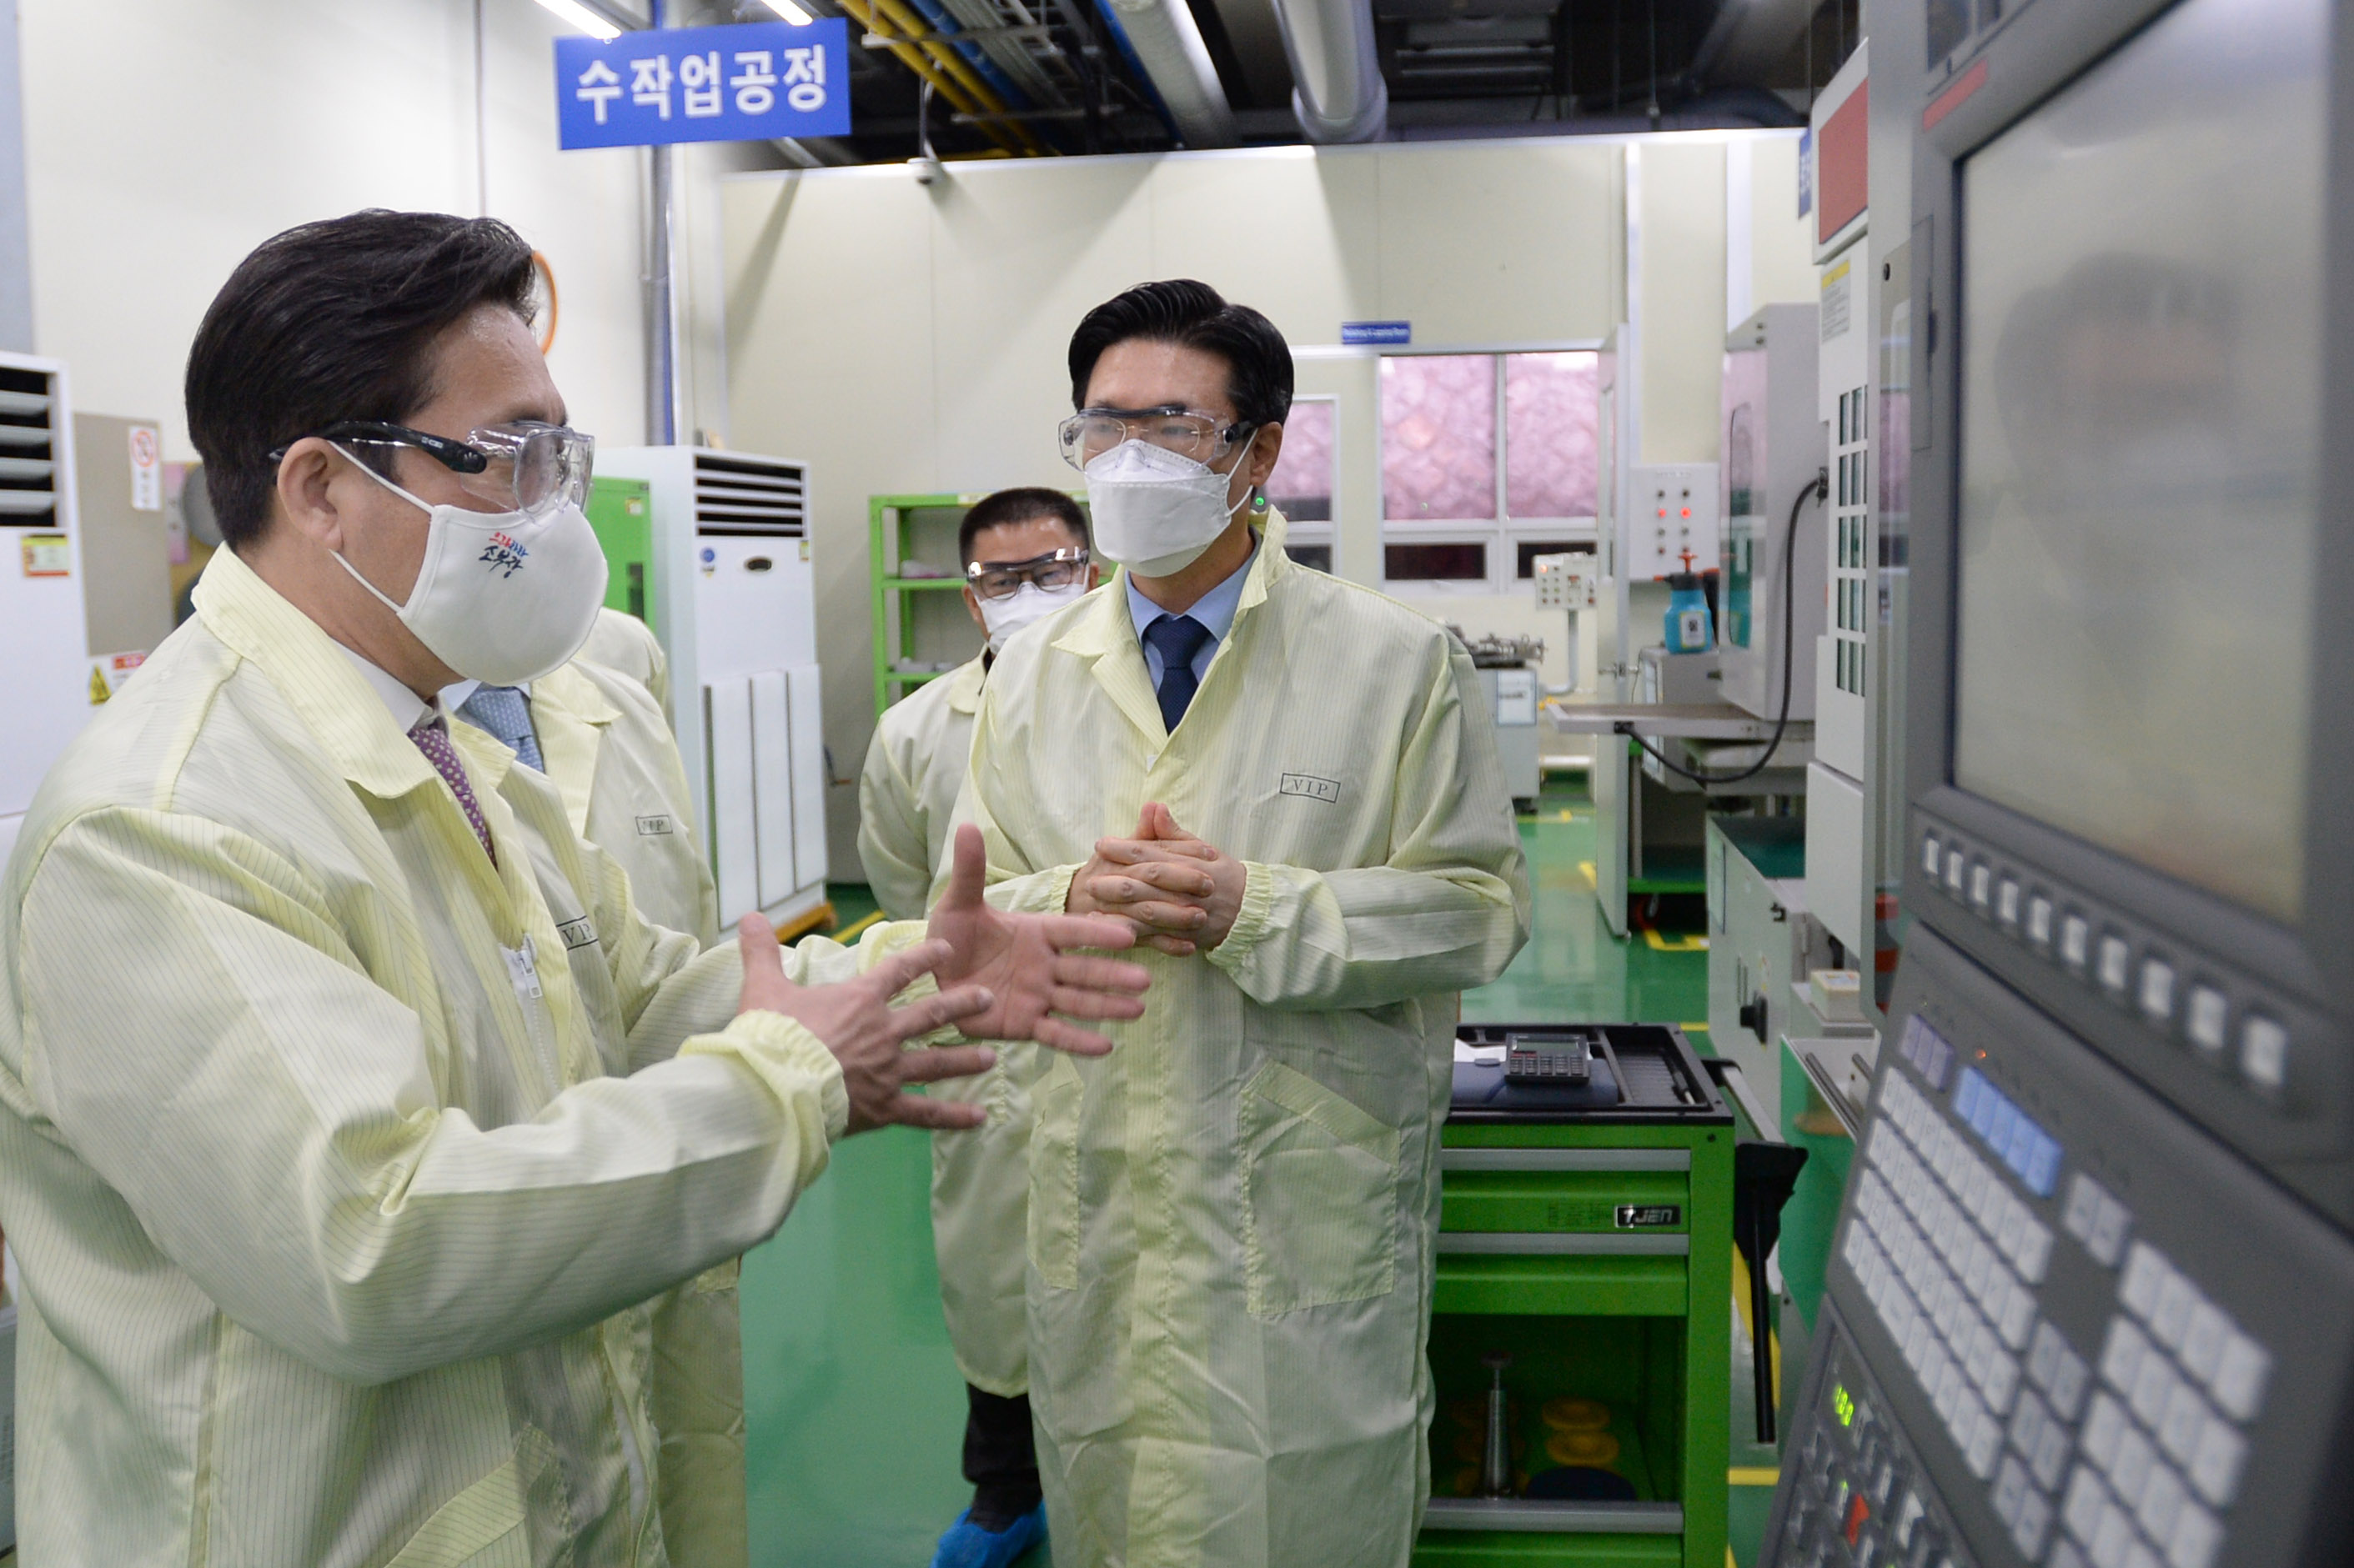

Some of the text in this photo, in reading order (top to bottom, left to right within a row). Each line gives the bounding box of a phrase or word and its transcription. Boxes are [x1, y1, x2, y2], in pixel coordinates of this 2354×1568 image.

[576, 44, 827, 124] 수작업공정
[479, 545, 524, 579] 소부장
[1293, 779, 1328, 795] VIP
